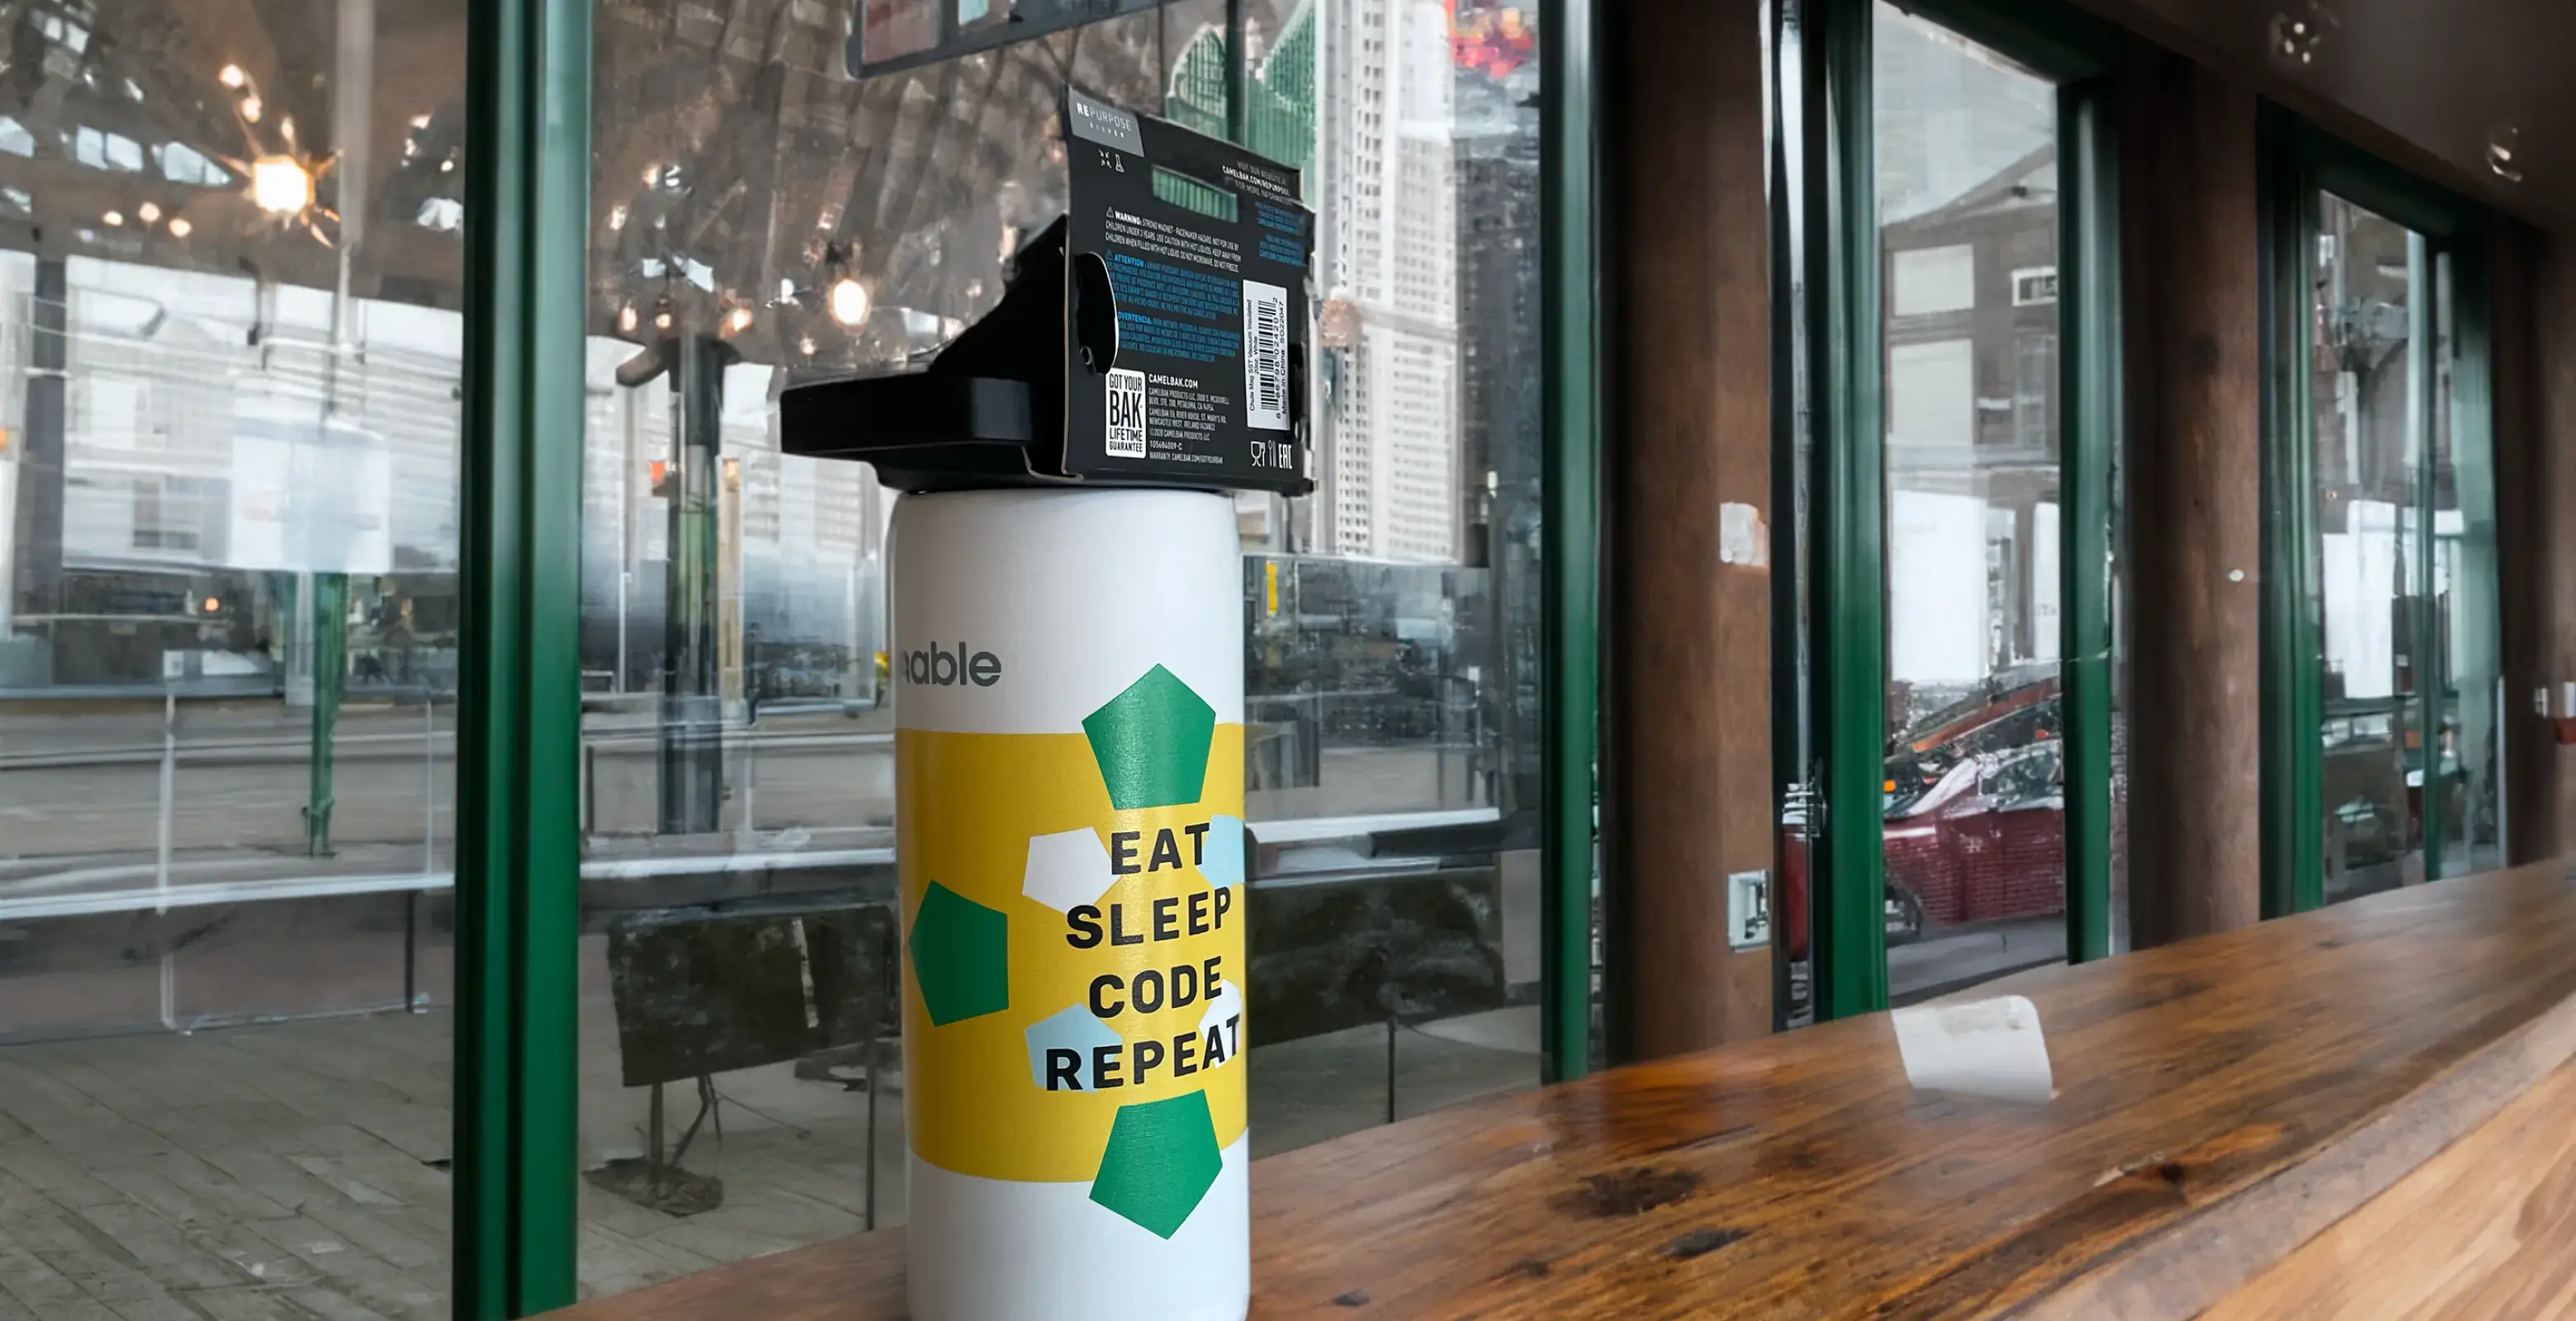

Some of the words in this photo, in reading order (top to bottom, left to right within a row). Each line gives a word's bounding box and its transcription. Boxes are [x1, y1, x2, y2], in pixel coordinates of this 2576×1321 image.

[1077, 102, 1132, 131] REPURPOSE
[1110, 373, 1123, 390] GOT
[1124, 375, 1143, 392] YOUR
[1148, 373, 1199, 389] CAMELBAK.COM
[1110, 390, 1143, 428] BAK
[1110, 427, 1144, 442] LIFETIME
[1110, 441, 1144, 452] GUARANTEE
[1111, 822, 1210, 875] EAT
[1066, 887, 1231, 949] SLEEP
[1089, 955, 1222, 1018] CODE
[1046, 1014, 1240, 1091] REPEAT
